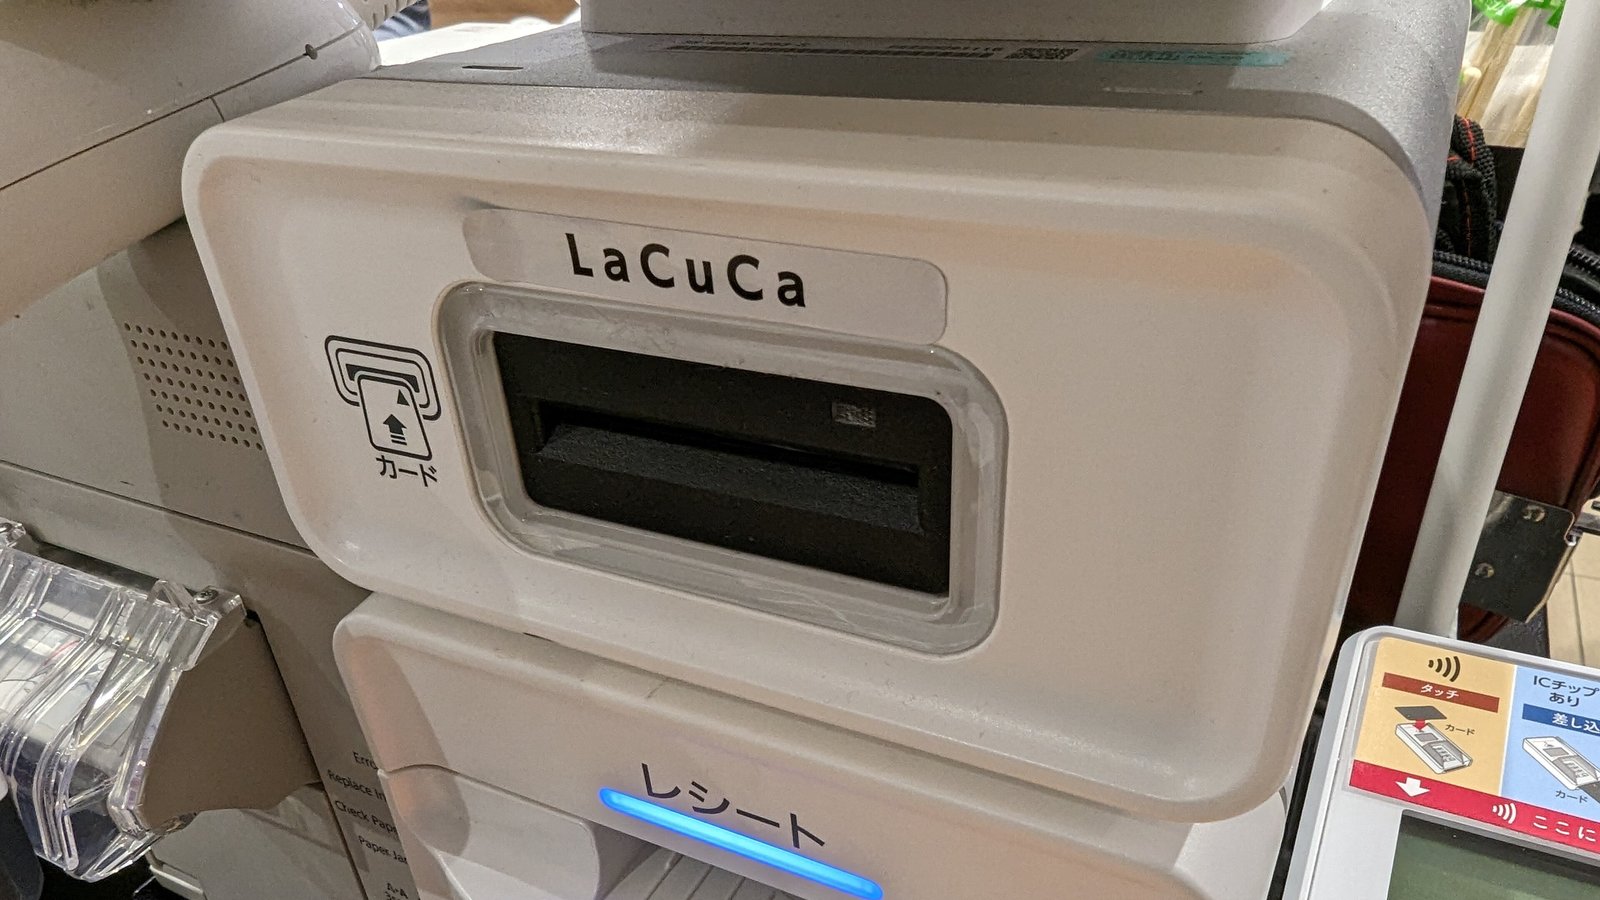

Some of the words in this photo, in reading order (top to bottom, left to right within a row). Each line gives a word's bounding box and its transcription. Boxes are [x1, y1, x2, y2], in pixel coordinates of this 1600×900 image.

[564, 232, 807, 308] LaCuCa
[375, 454, 438, 487] カード
[1420, 683, 1460, 700] タッチ
[1533, 675, 1600, 697] ICチップ
[1549, 692, 1580, 707] あり
[1444, 723, 1476, 736] カード
[328, 769, 373, 796] Replace
[641, 762, 826, 849] レシート
[1555, 789, 1588, 804] カード
[334, 800, 370, 823] Check
[1532, 814, 1597, 843] ここに
[358, 835, 391, 857] Paper
